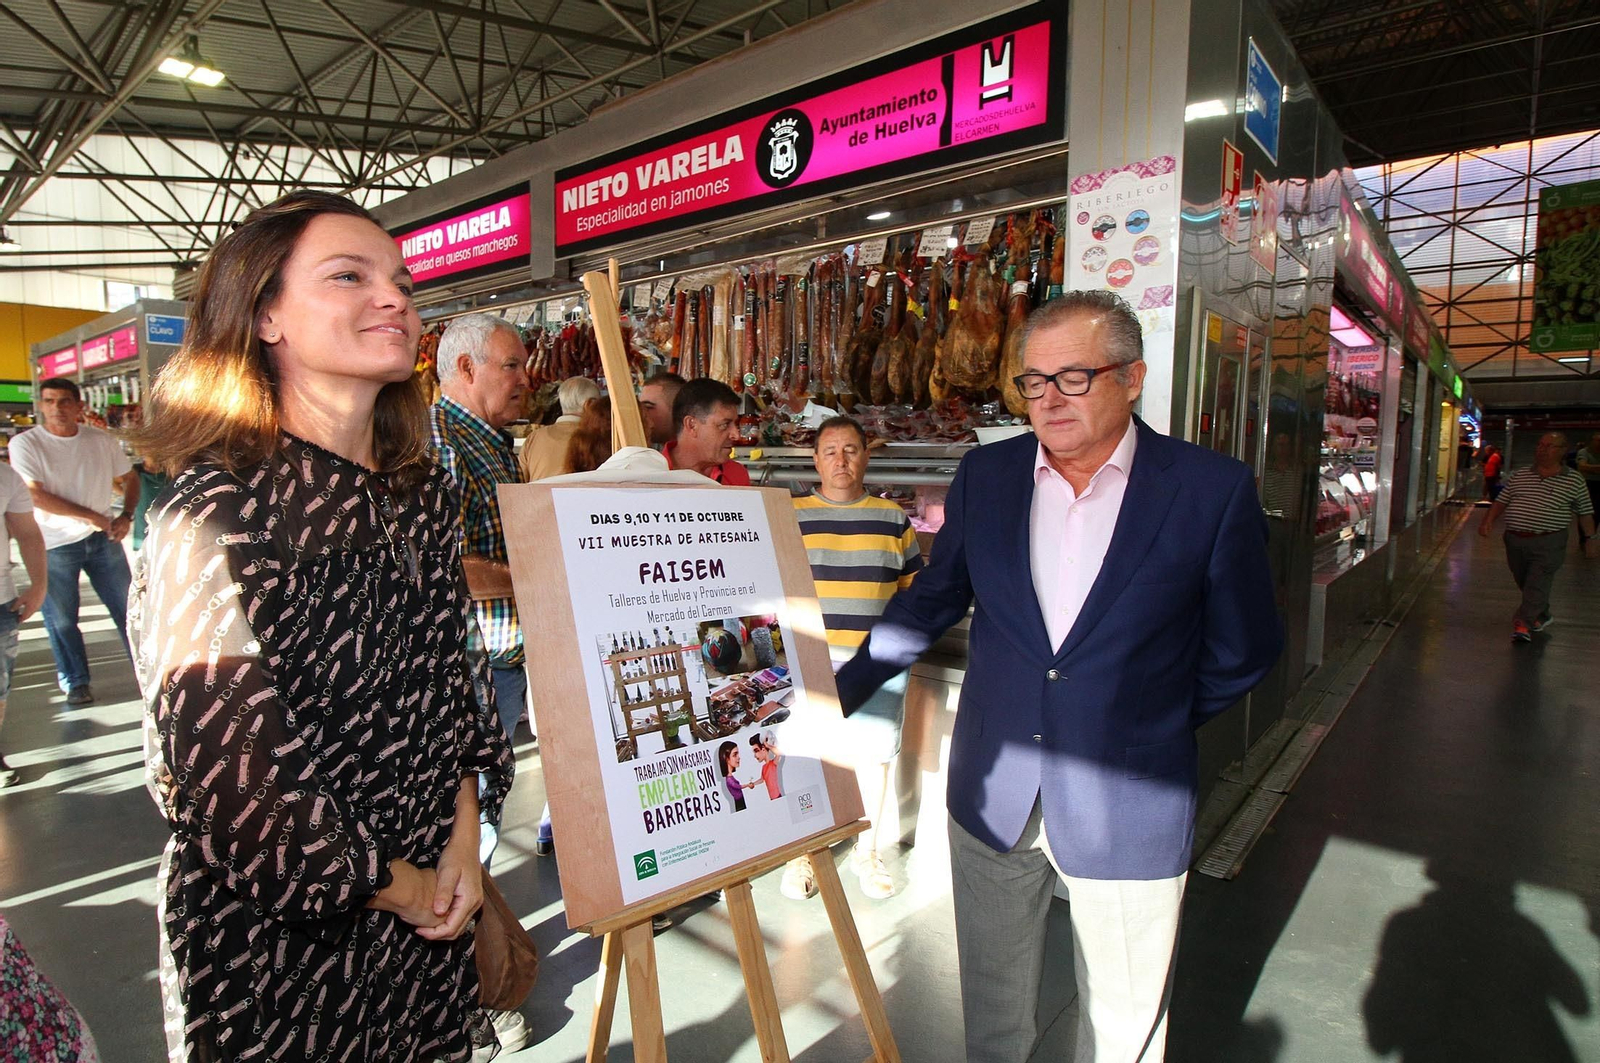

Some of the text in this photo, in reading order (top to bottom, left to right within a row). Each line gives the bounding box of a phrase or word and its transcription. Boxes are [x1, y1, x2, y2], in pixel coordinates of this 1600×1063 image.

[819, 88, 938, 135] Ayuntamiento
[849, 112, 937, 147] de Huelva
[563, 134, 744, 213] NIETO VARELA
[576, 178, 730, 232] Especialidad en jamones
[1076, 182, 1169, 210] RIBERIEGO
[402, 206, 511, 259] NIETO VARELA
[435, 253, 445, 268] en
[446, 245, 471, 266] quesos
[472, 233, 518, 257] manchegos
[590, 511, 744, 526] DIAS 9,10 Y 11 DE OCTUBRE
[579, 528, 760, 549] VII MUESTRA DE ARTESANÍA
[639, 558, 726, 585] FAISEM
[608, 582, 756, 608] Talleres de Huelva y Provincia en el
[647, 604, 733, 624] Mercado del Carmen
[634, 749, 712, 782] TRABAJAR SIN MÁSCARAS
[638, 765, 716, 809] EMPLEAR SIN
[643, 791, 721, 835] BARRERAS
